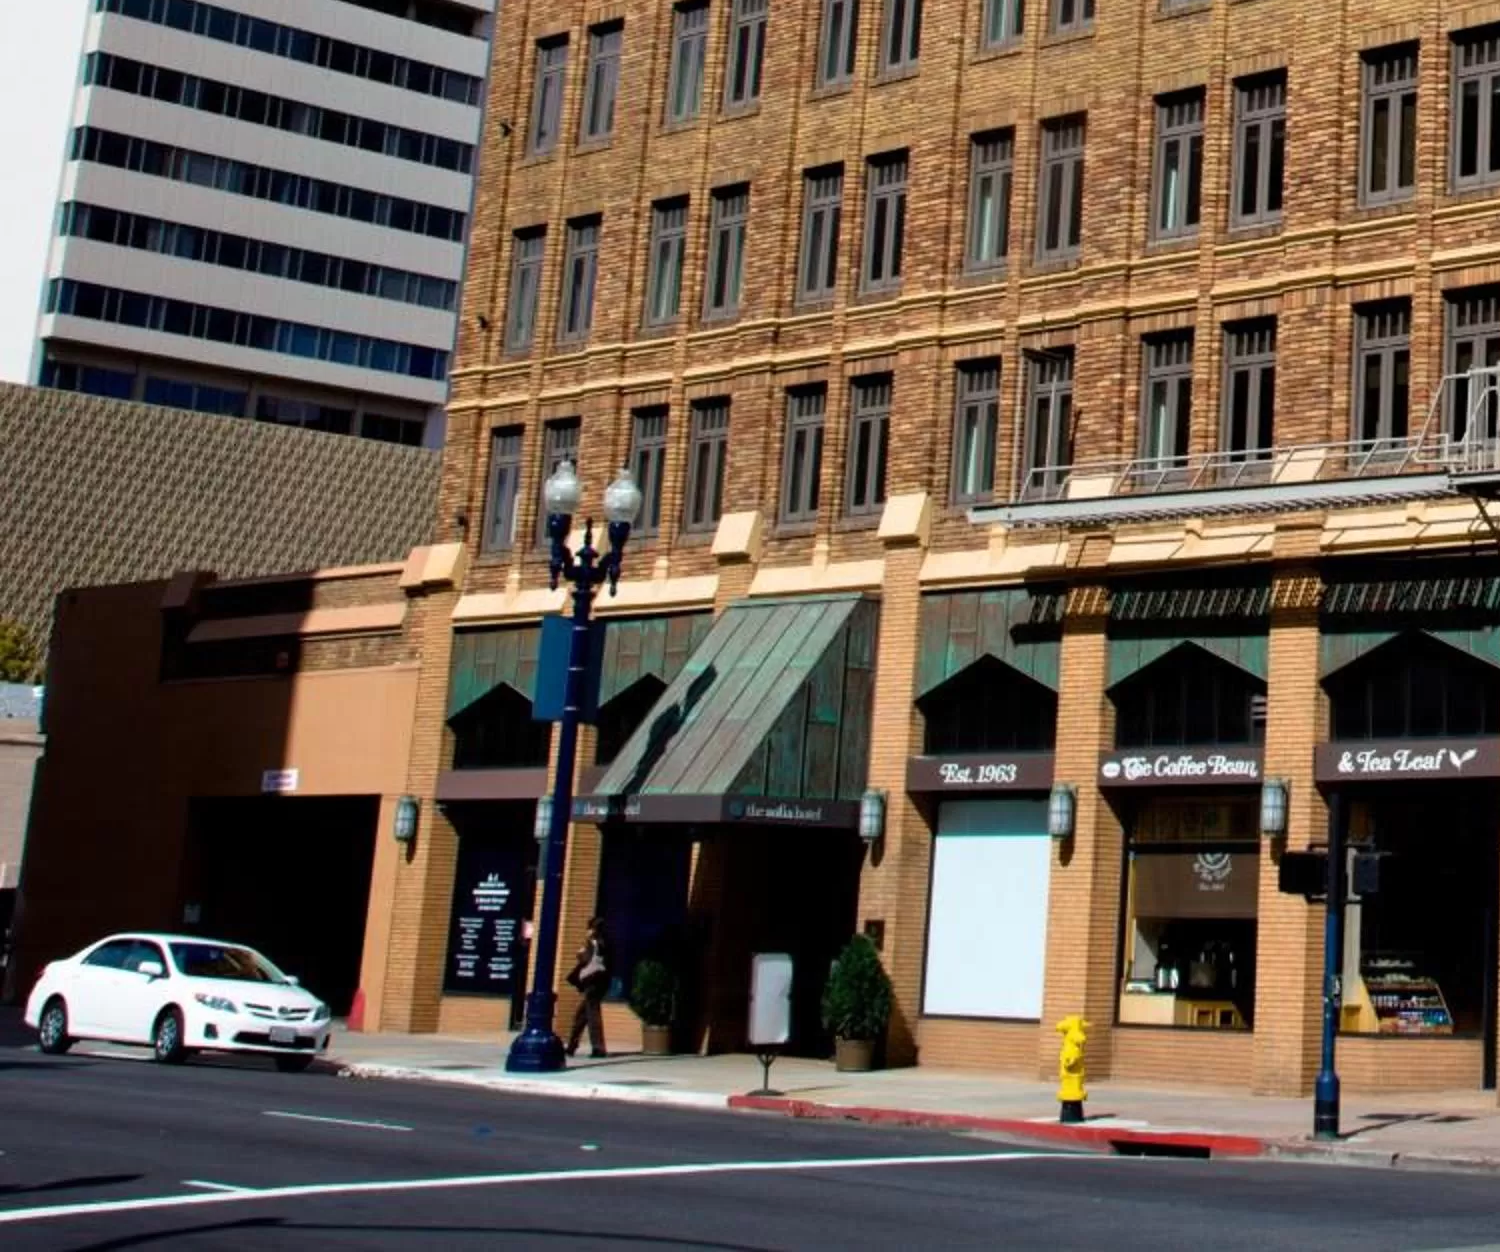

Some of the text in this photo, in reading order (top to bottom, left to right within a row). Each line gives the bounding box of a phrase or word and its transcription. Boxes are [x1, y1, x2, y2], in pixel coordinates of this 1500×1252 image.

[939, 762, 1018, 784] Est. 1963
[1121, 754, 1259, 780] The Coffee Bean
[1337, 748, 1447, 773] & Tea Leaf
